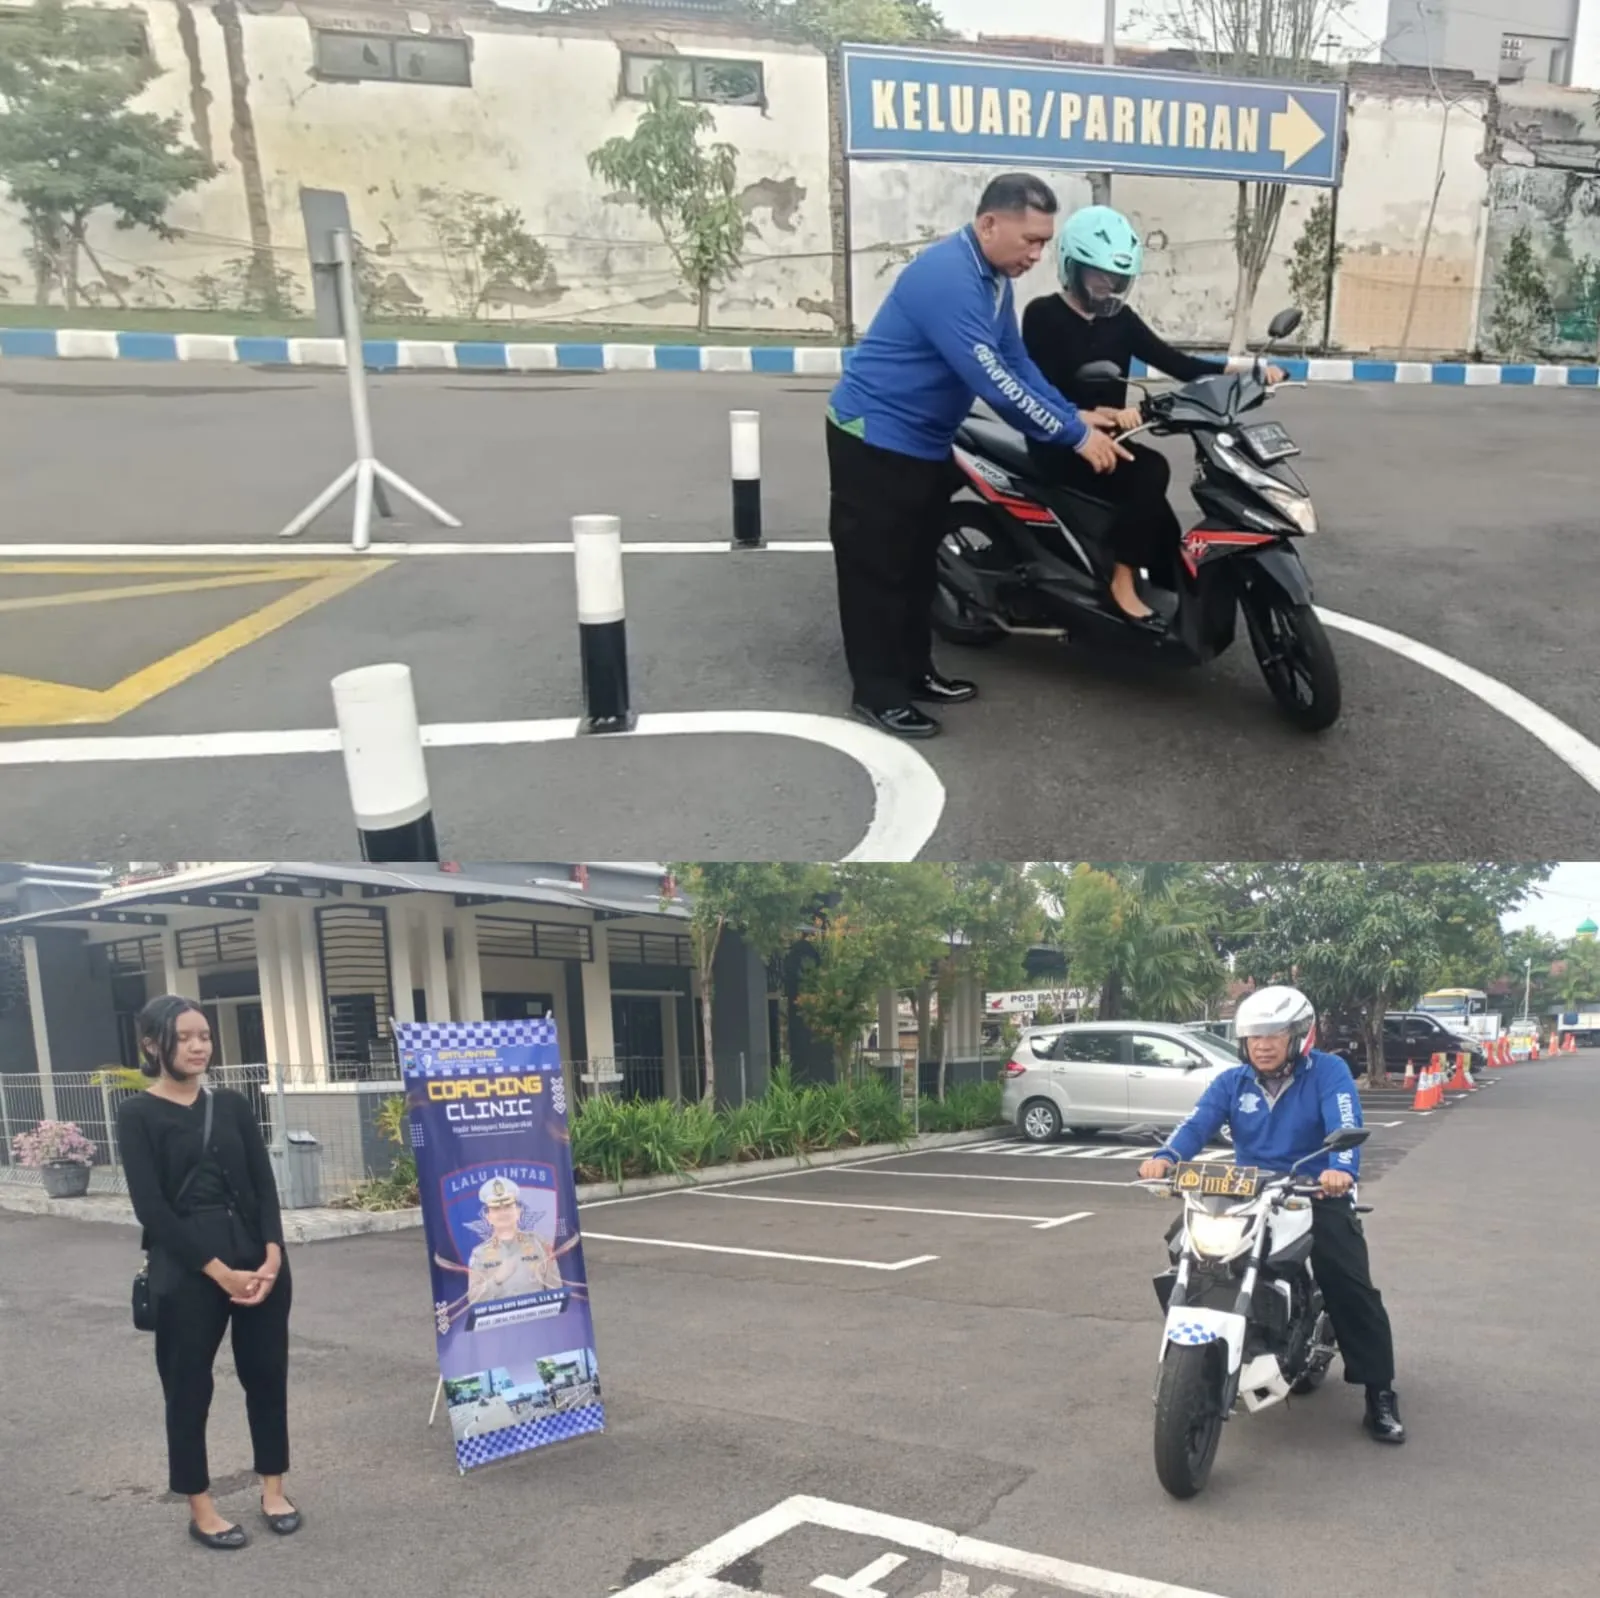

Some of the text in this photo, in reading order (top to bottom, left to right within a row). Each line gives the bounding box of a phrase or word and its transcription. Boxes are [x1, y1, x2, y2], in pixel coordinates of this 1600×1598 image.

[871, 79, 1259, 153] KELUAR/PARKIRAN
[1016, 395, 1063, 435] SATPAS
[427, 1076, 543, 1100] COACHING
[446, 1099, 533, 1121] CLINIC
[451, 1167, 547, 1193] LALU LINTAS
